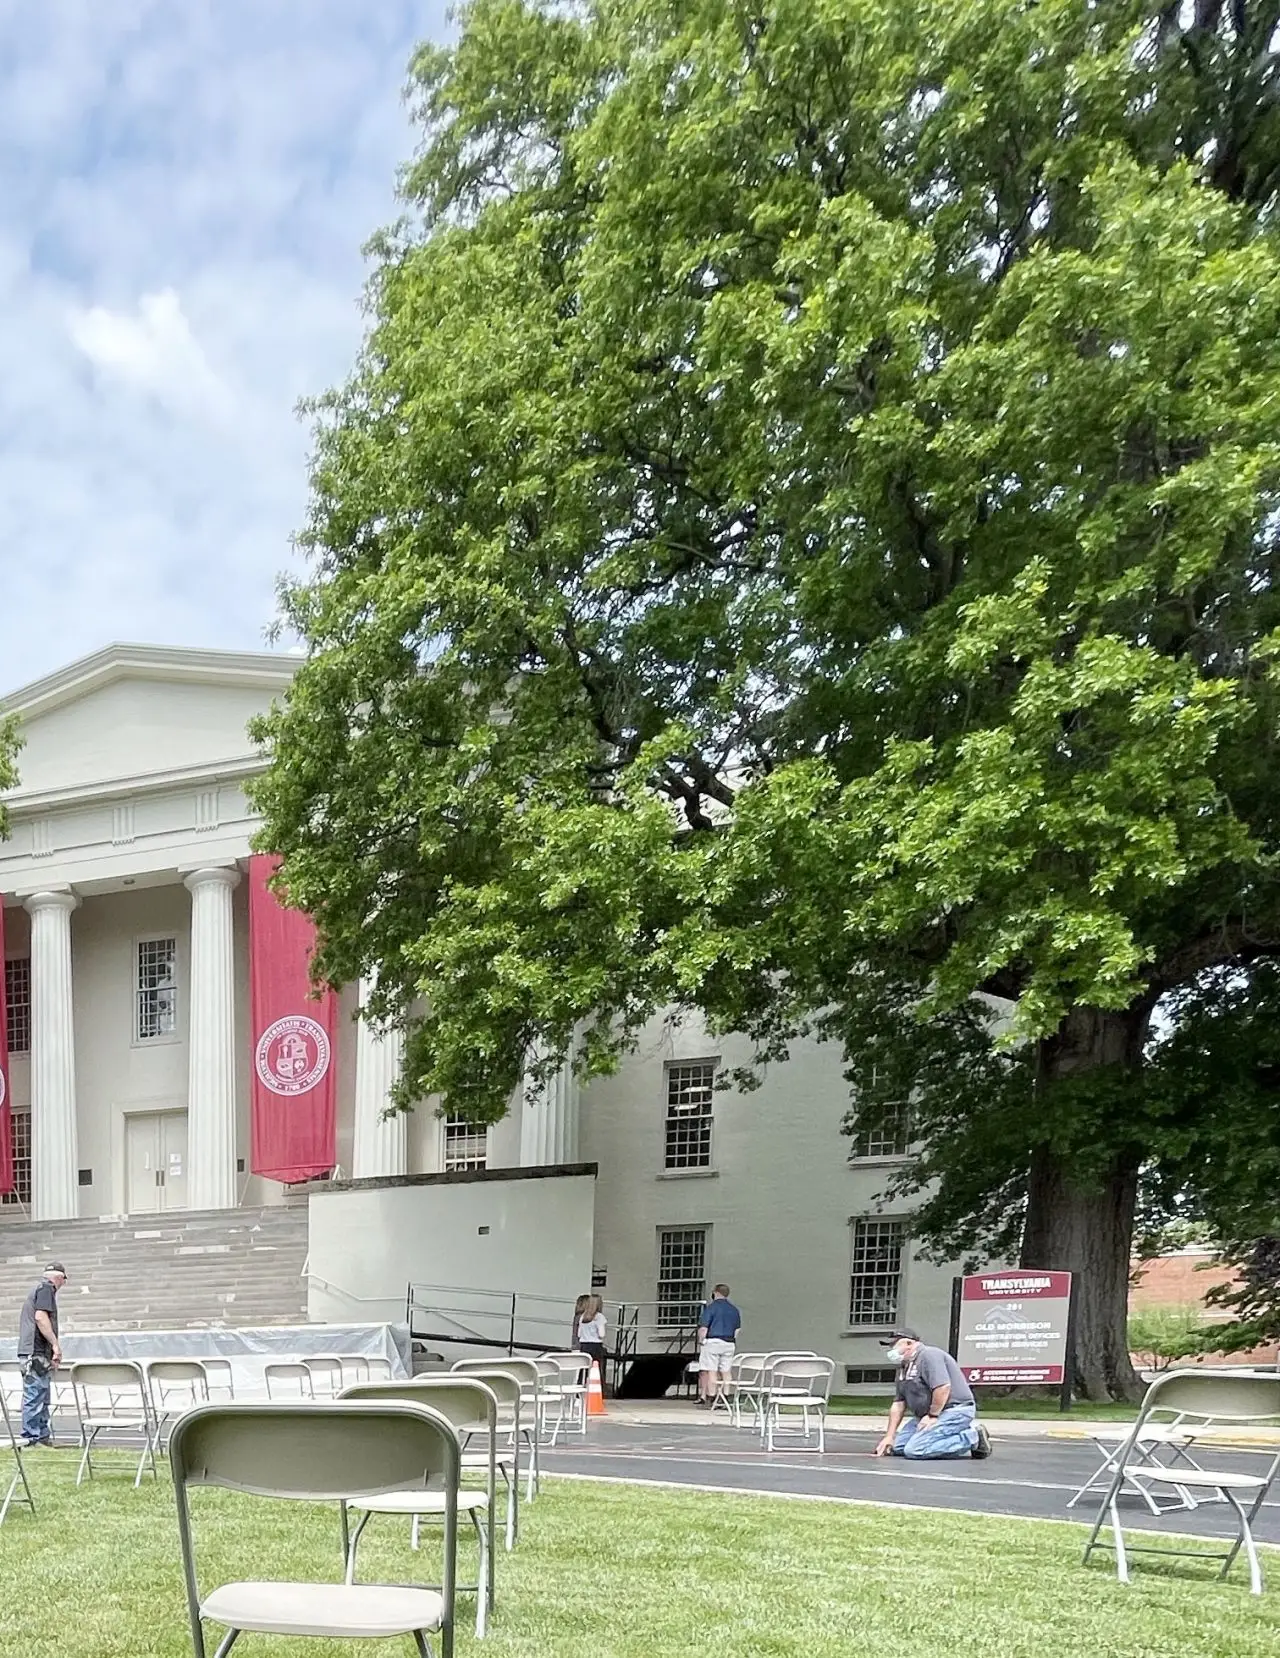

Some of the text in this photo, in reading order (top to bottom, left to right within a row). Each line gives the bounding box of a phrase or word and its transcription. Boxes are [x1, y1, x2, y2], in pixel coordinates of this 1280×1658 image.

[981, 1277, 1051, 1290] TRANSYLVANIA
[975, 1322, 1051, 1331] OLD MORRISON
